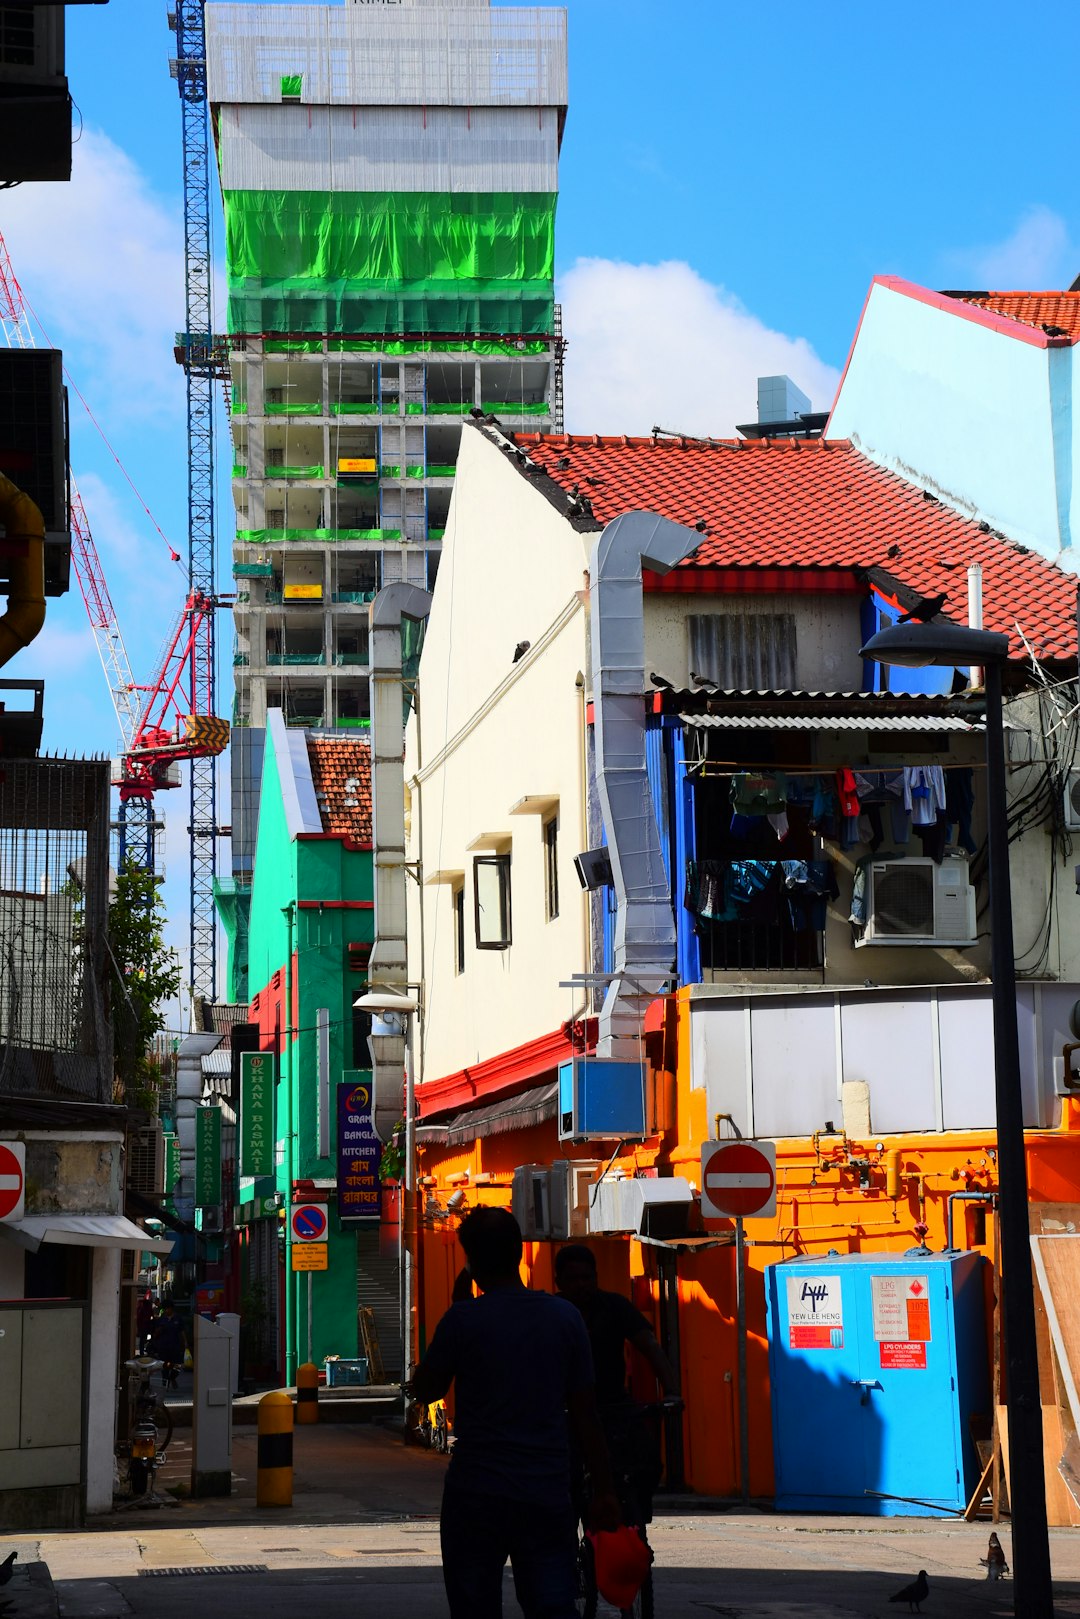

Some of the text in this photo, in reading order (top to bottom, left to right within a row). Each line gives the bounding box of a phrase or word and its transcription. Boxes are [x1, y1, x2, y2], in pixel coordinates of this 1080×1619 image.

[251, 1068, 264, 1173] KHANA BASMATI
[347, 1115, 371, 1124] GRAM
[344, 1131, 377, 1140] BANGLA
[342, 1147, 376, 1156] KITCHEN
[202, 1119, 214, 1205] KHANA BASMATI
[351, 1160, 370, 1172] গ্রাম
[345, 1175, 375, 1186] বাংলা
[880, 1281, 895, 1289] LPG
